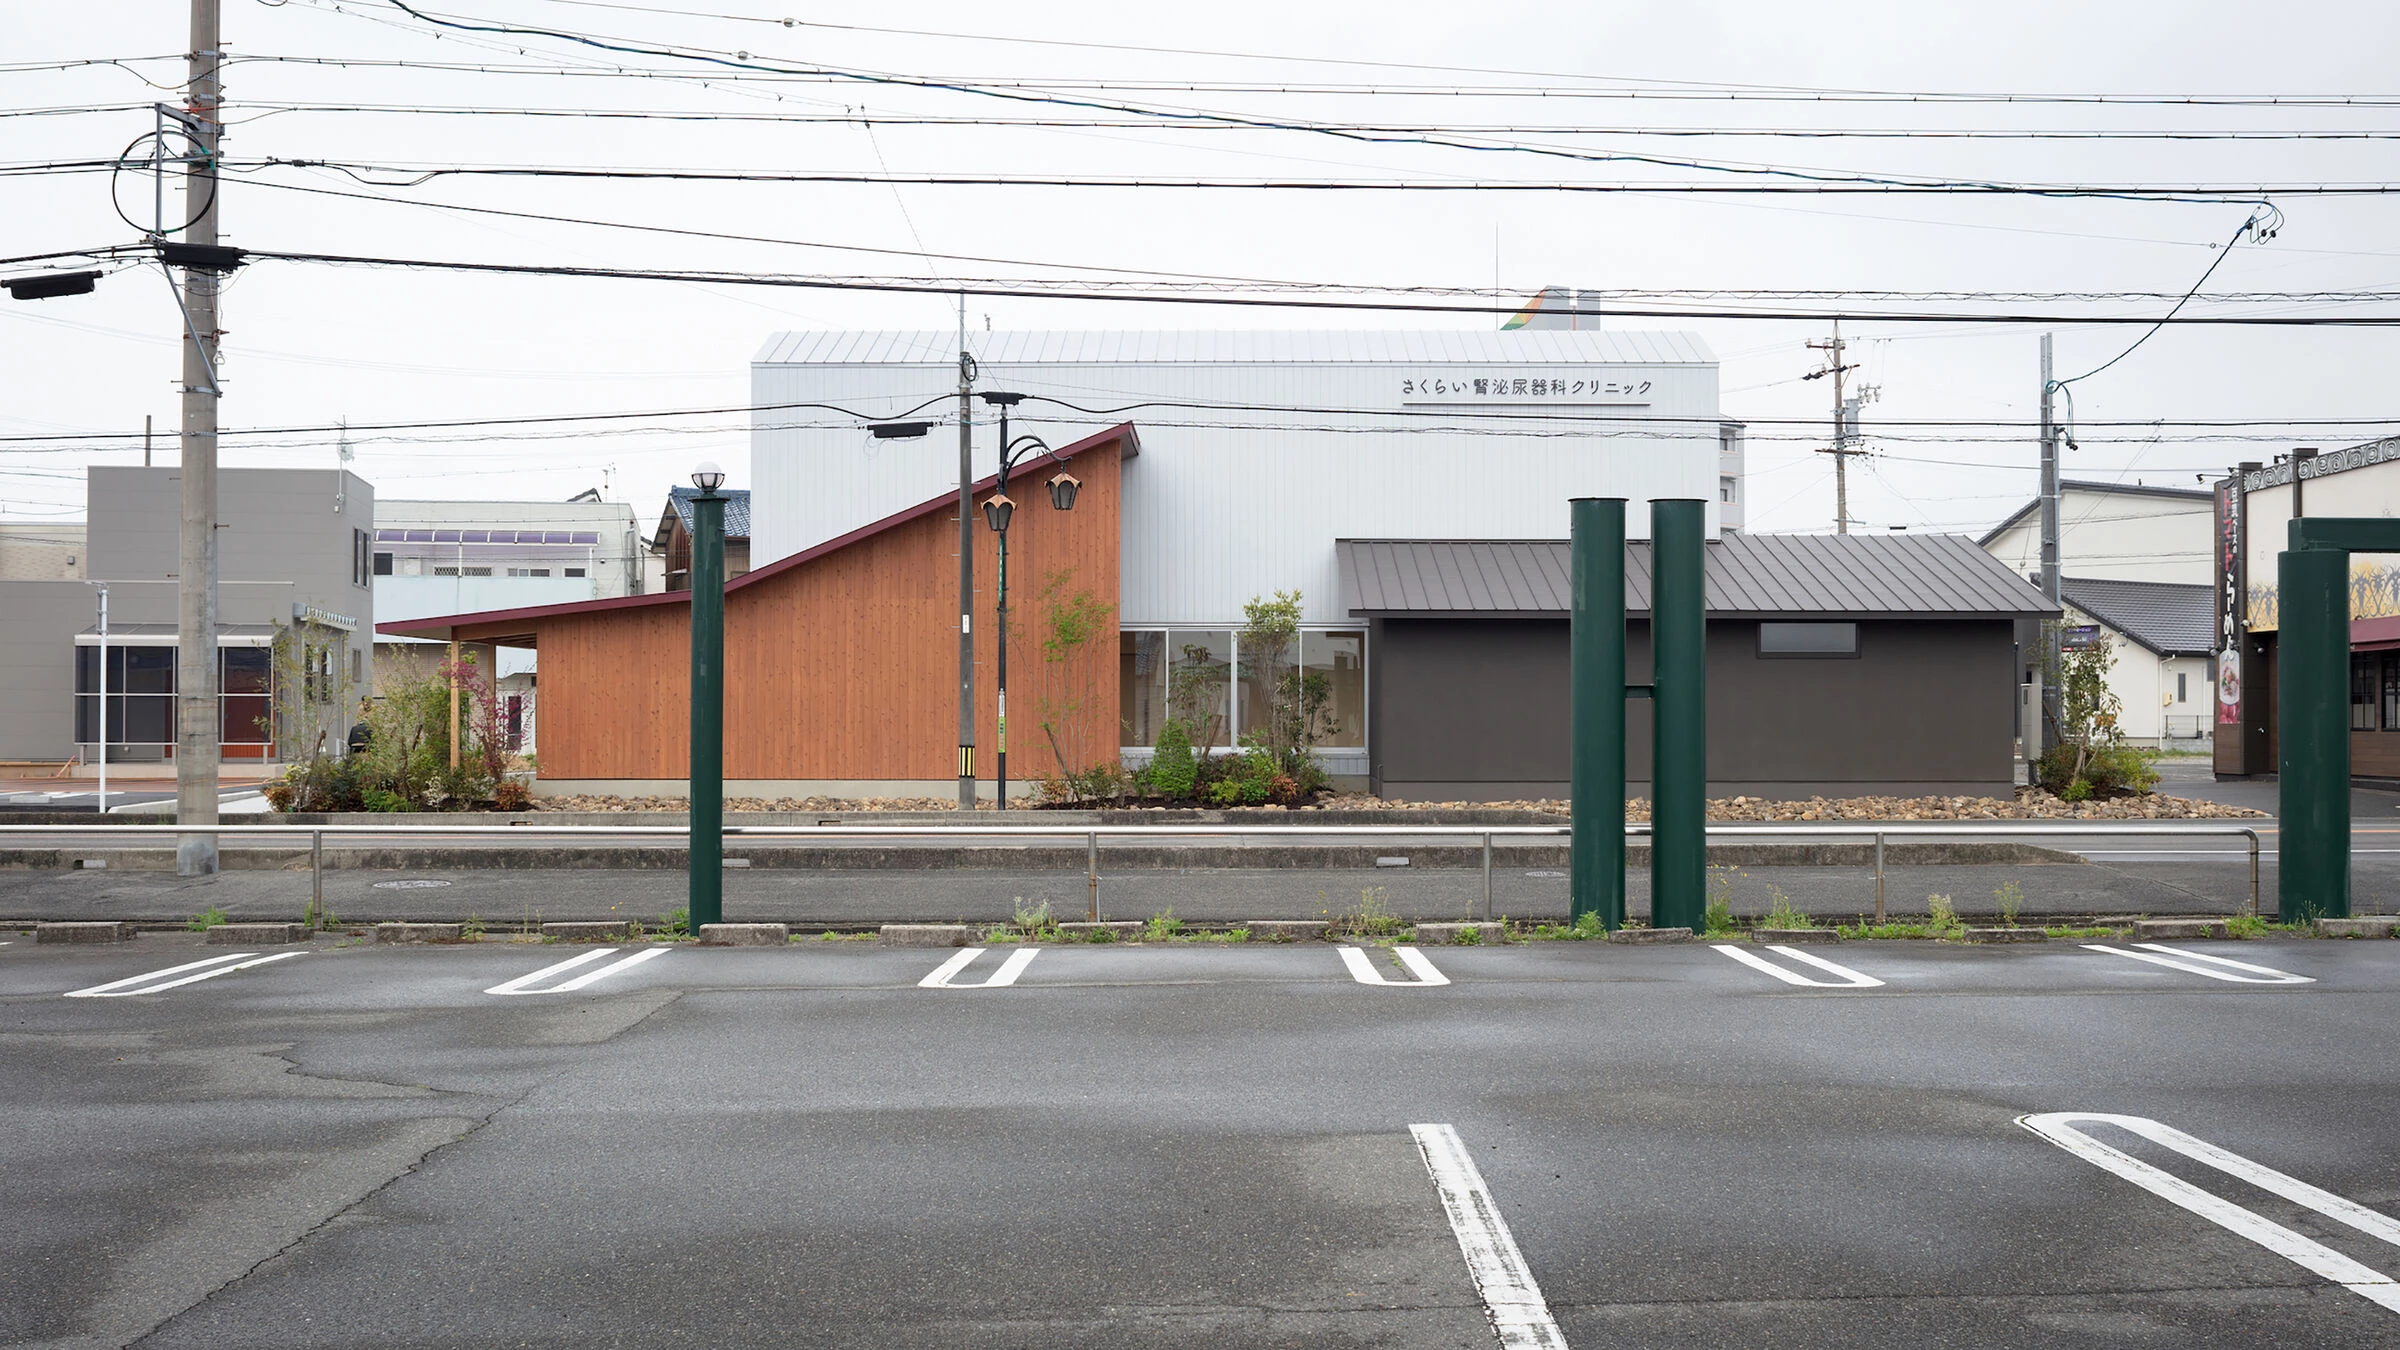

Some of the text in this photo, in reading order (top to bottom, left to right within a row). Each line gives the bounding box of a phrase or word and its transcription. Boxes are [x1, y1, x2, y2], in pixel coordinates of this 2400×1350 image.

[1402, 378, 1652, 396] さくらい腎泌尿器科クリニック
